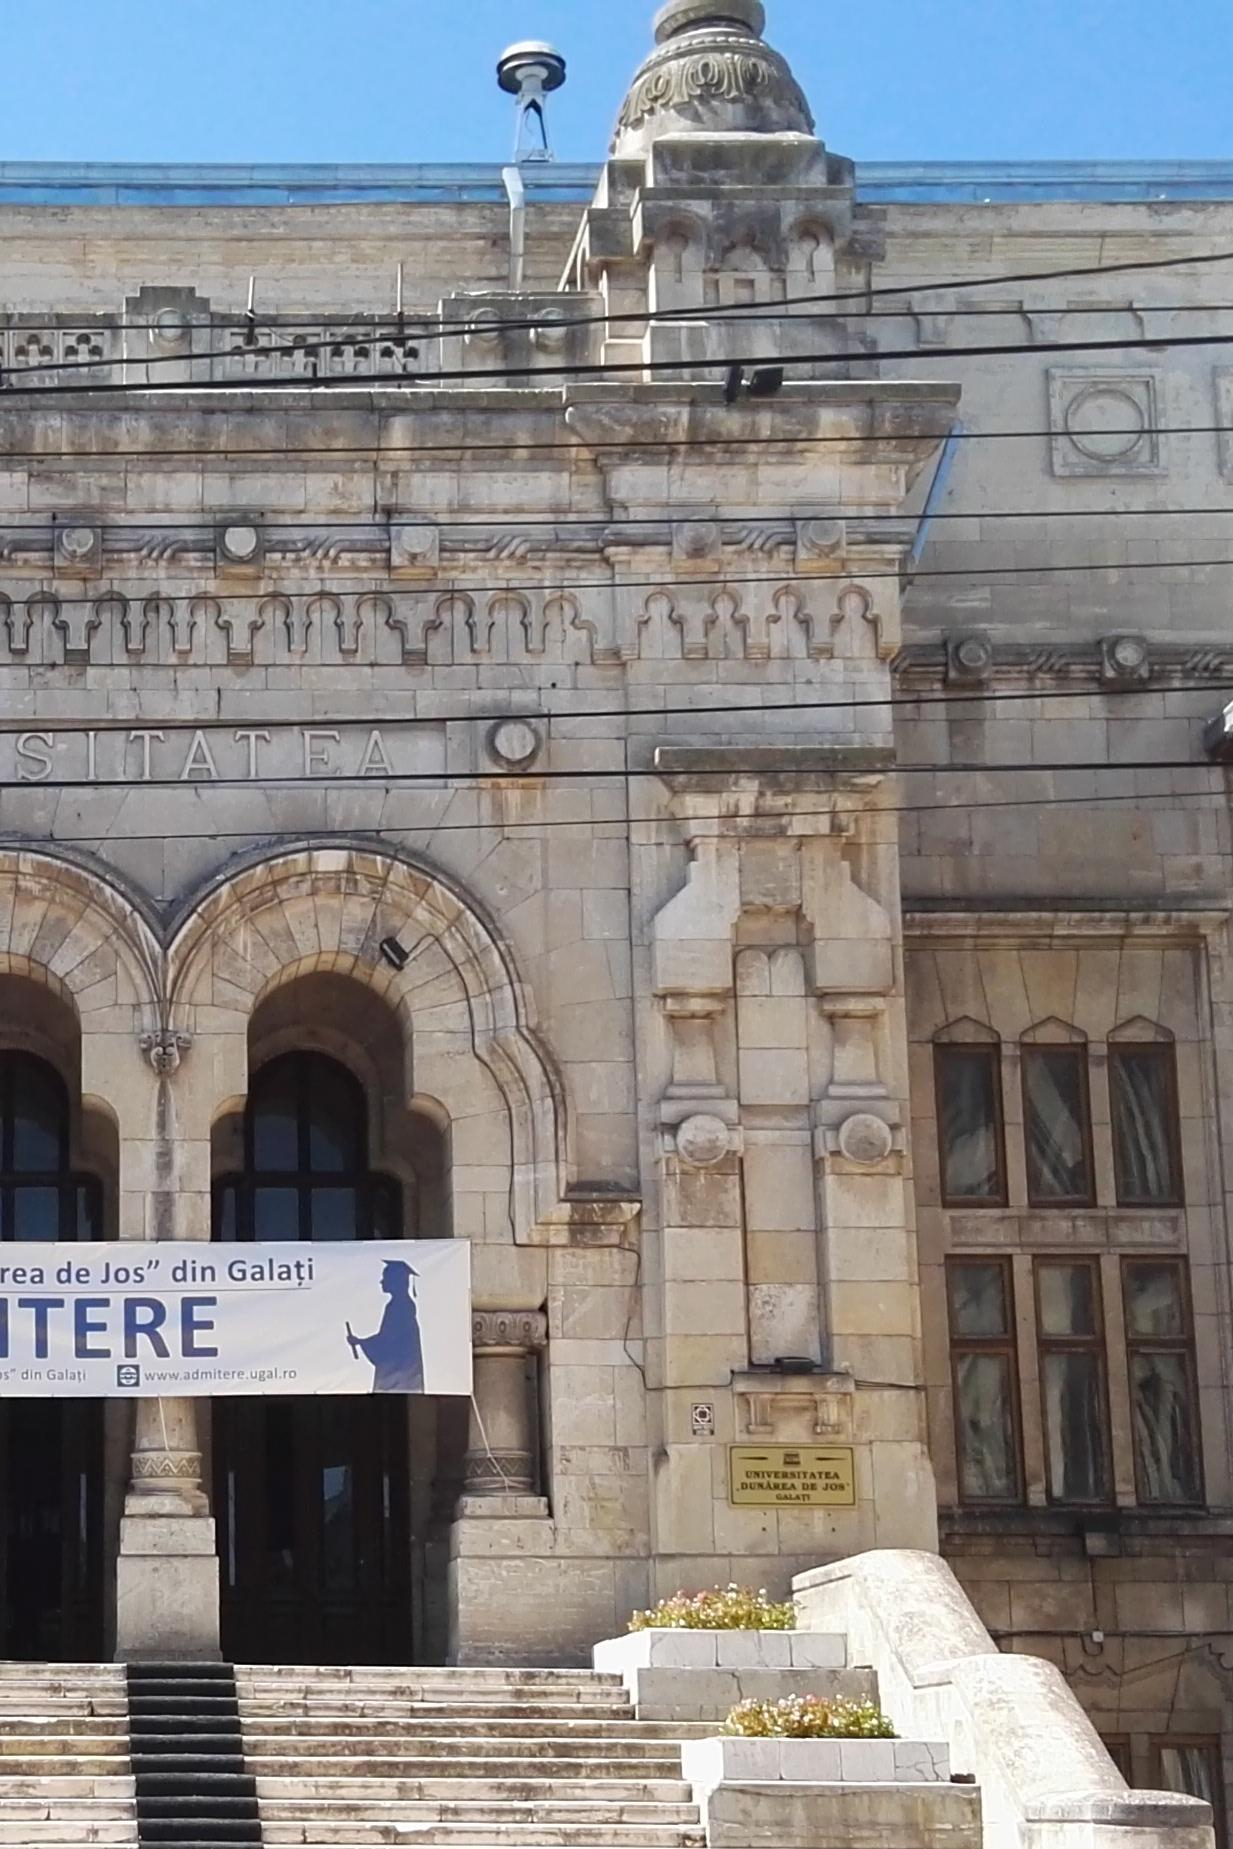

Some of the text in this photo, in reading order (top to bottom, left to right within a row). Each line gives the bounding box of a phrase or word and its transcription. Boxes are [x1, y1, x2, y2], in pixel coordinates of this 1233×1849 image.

[56, 1261, 90, 1284] de
[101, 1259, 161, 1284] Jos”
[171, 1259, 216, 1283] din
[227, 1258, 314, 1286] Galați
[21, 1367, 42, 1381] din
[46, 1368, 87, 1384] Galați
[144, 1367, 297, 1382] www.admitere.ugal.ro
[745, 1470, 841, 1480] UNIVERSITATEA
[801, 1482, 818, 1491] DE
